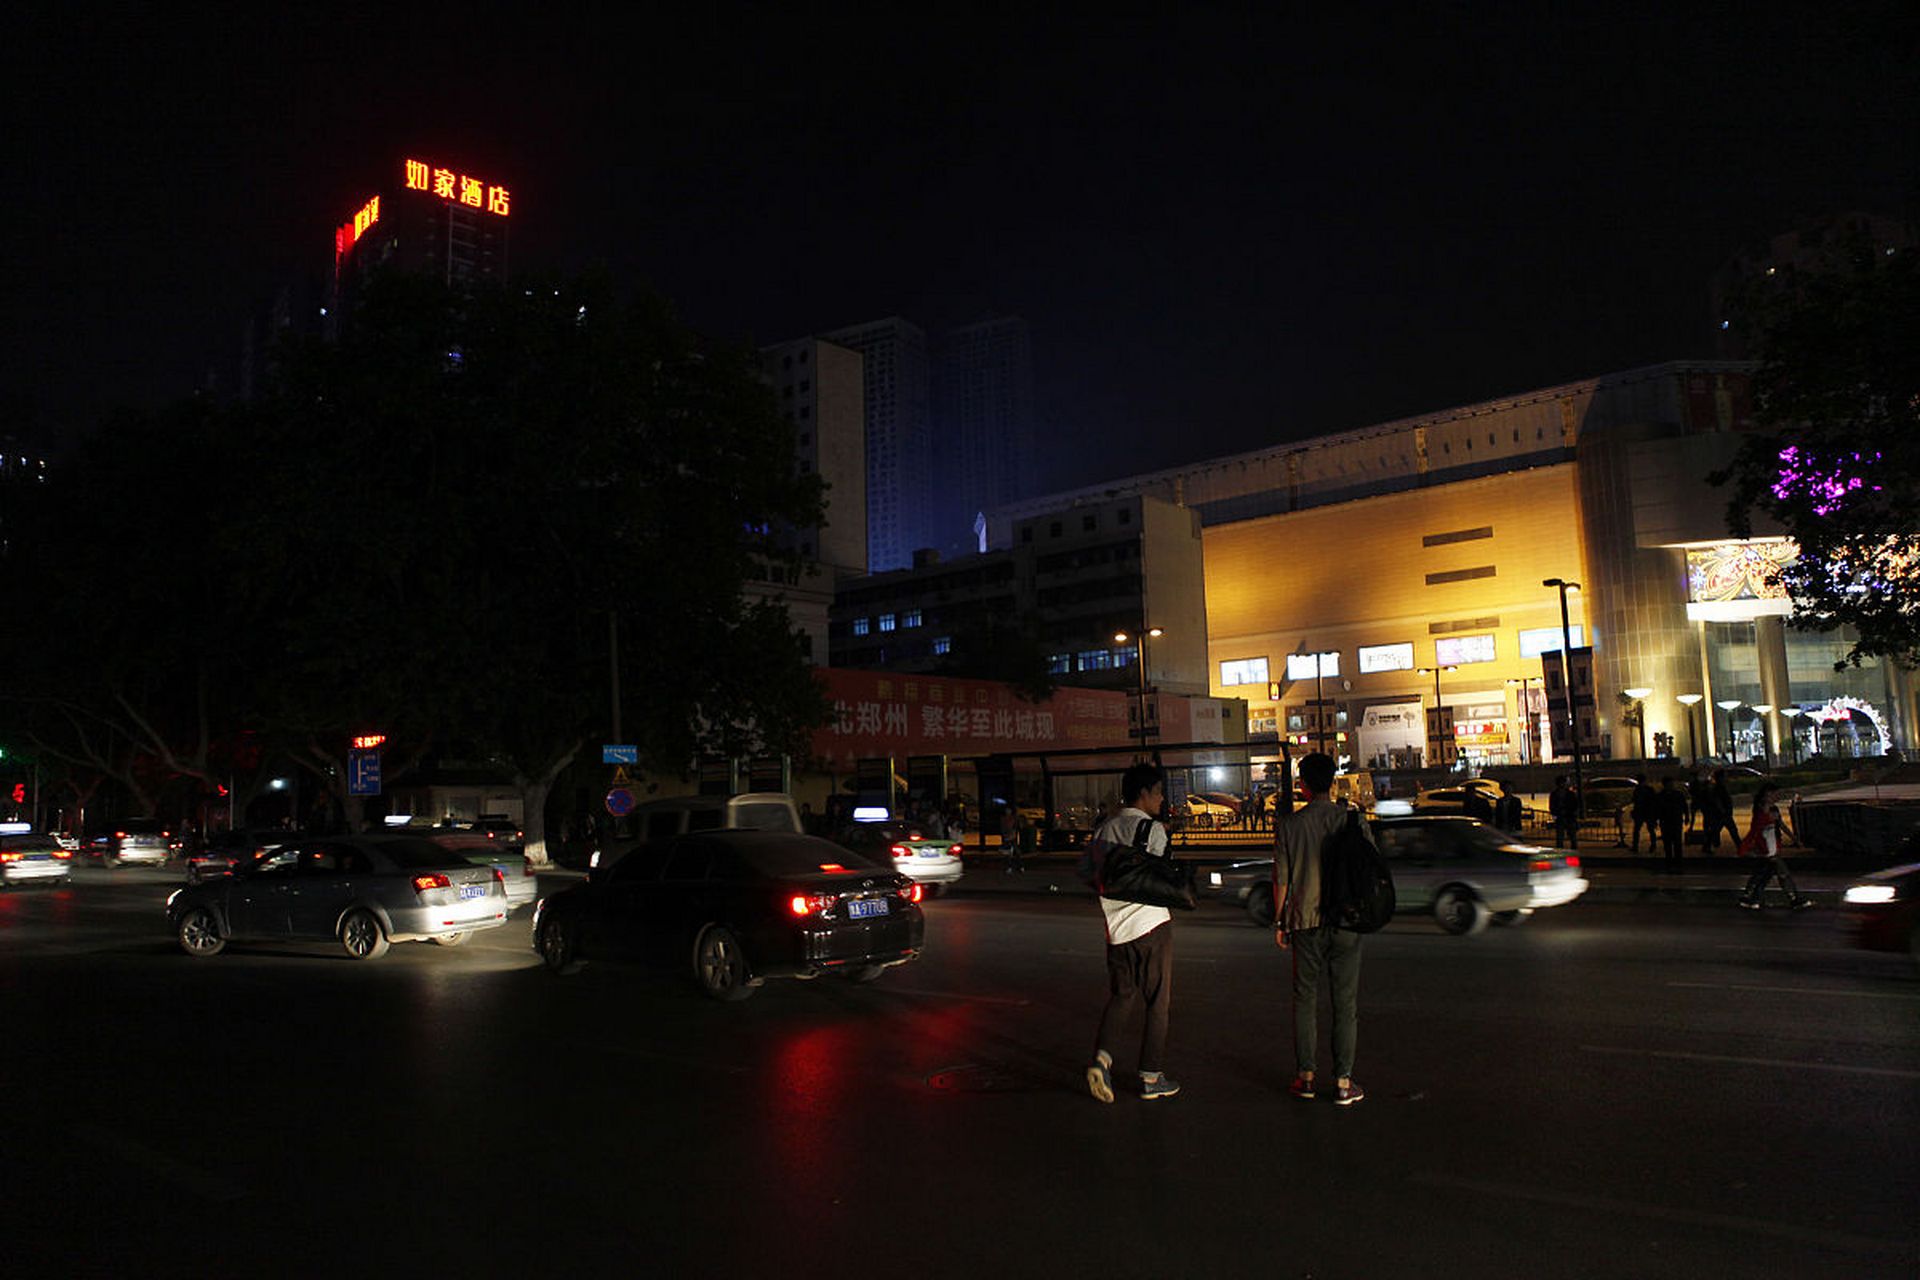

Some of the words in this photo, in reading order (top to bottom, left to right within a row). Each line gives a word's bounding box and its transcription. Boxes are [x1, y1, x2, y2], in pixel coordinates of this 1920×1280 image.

[405, 158, 511, 217] 如家酒店
[921, 704, 1056, 742] 繁华至此城现
